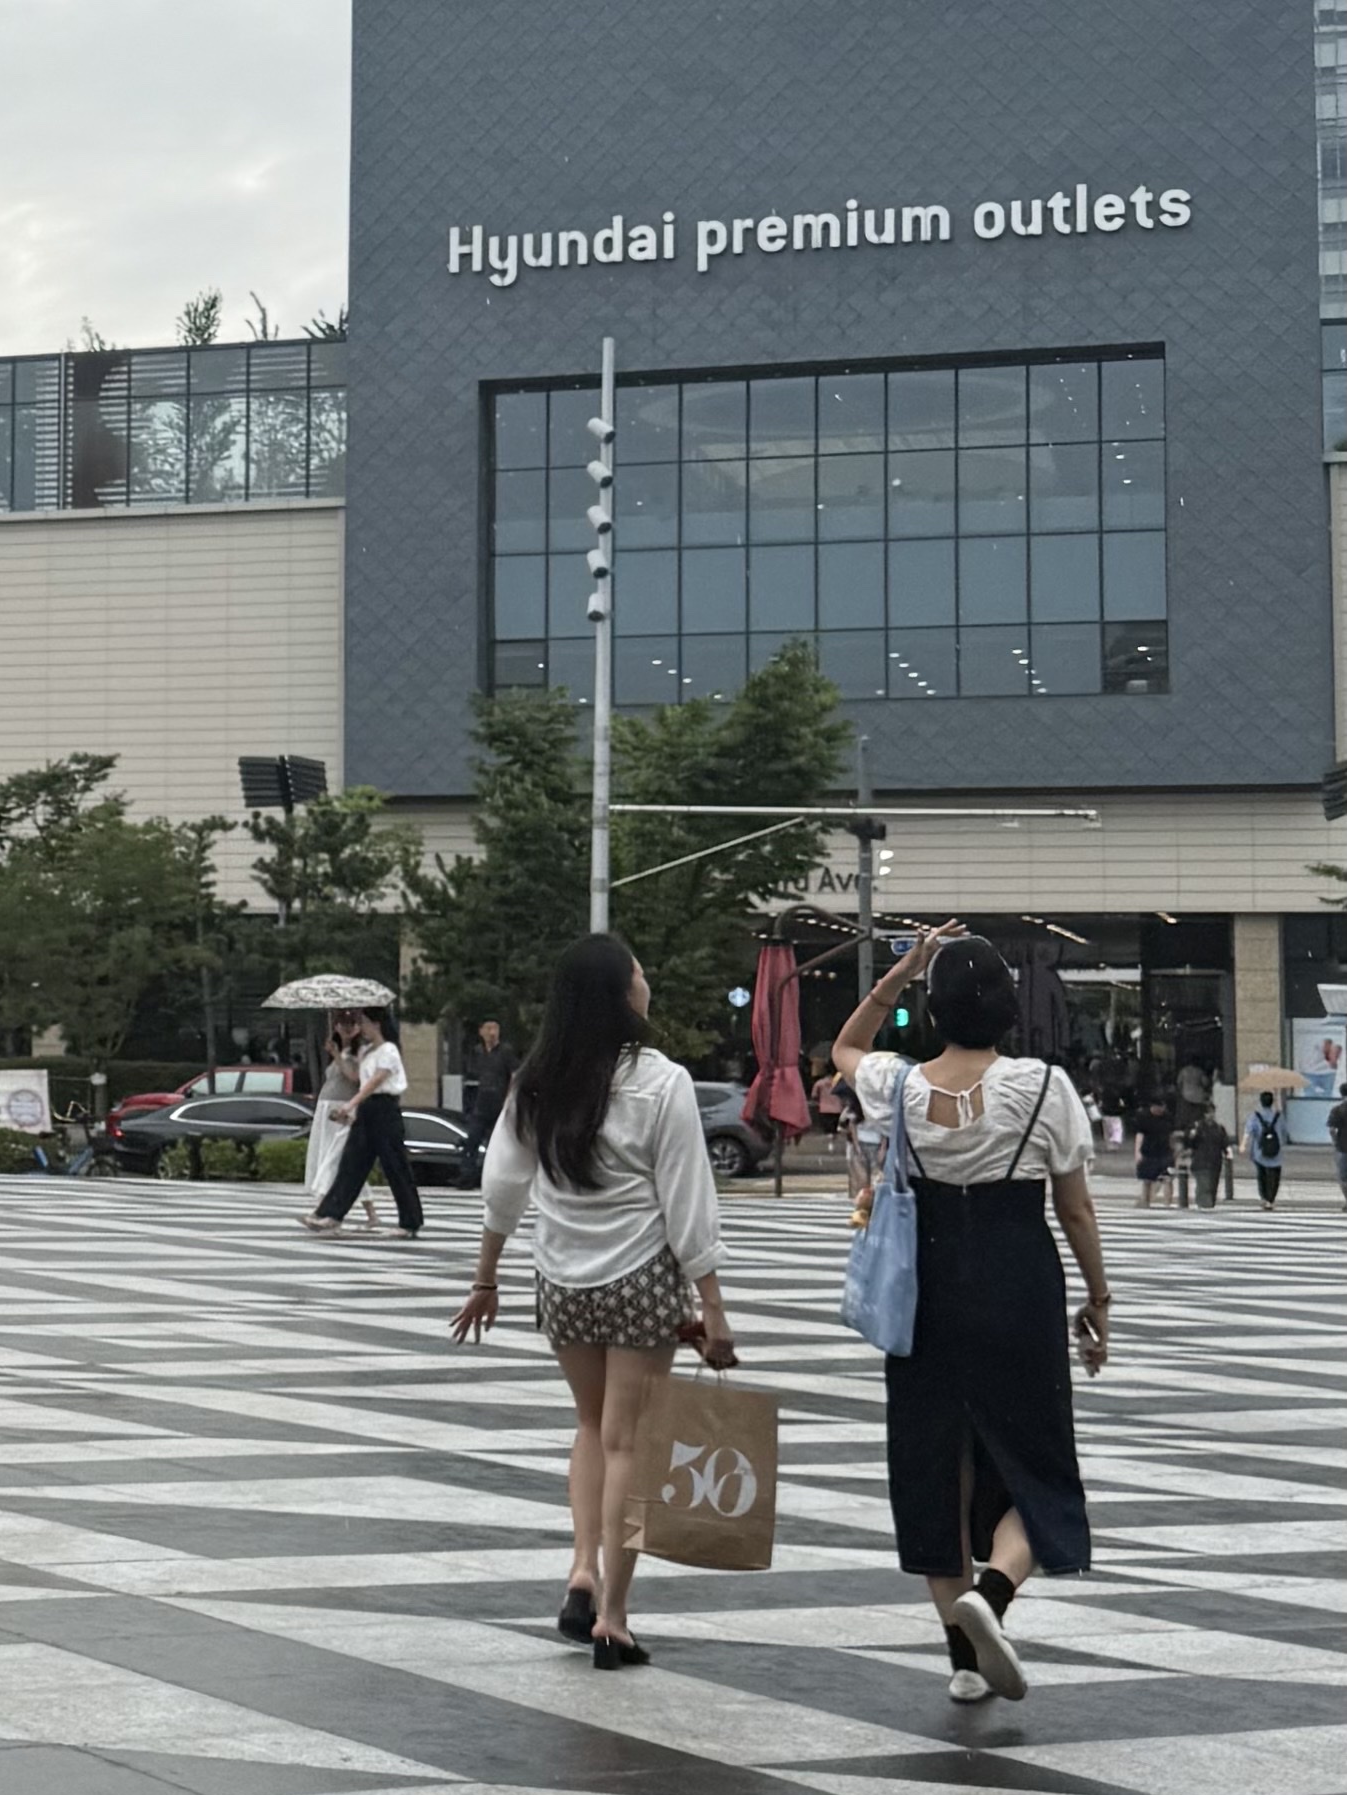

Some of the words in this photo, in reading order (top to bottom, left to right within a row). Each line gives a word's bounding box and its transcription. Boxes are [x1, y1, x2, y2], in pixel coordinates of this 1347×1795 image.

[447, 210, 675, 287] Hyundai
[697, 198, 950, 272] premium
[972, 183, 1192, 239] outlets
